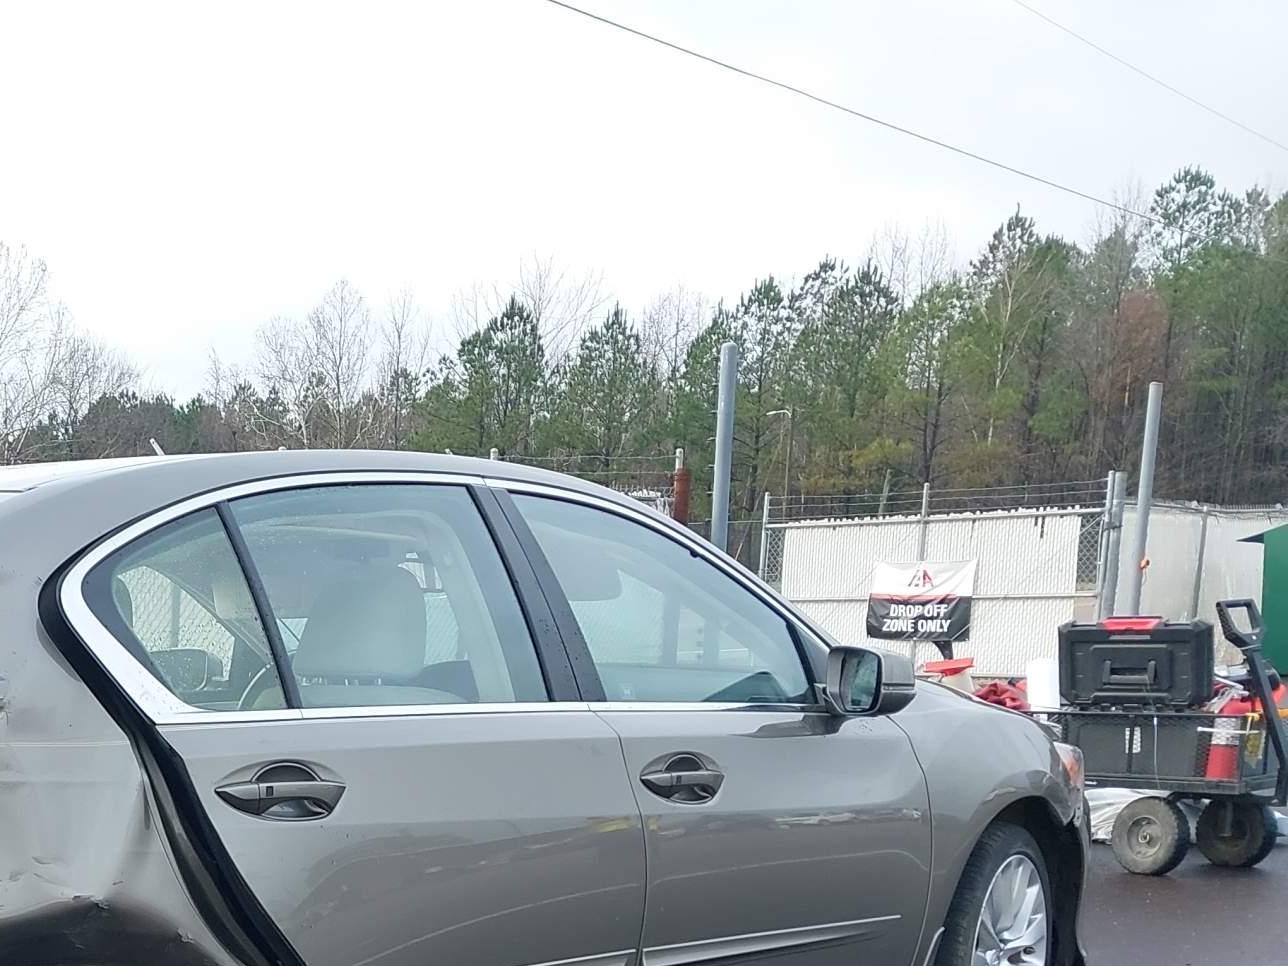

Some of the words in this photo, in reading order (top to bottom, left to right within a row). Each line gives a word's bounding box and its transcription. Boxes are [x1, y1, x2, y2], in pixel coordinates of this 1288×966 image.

[890, 604, 923, 617] DROP
[924, 604, 948, 617] OFF
[882, 619, 915, 632] ZONE
[918, 619, 951, 632] ONLY
